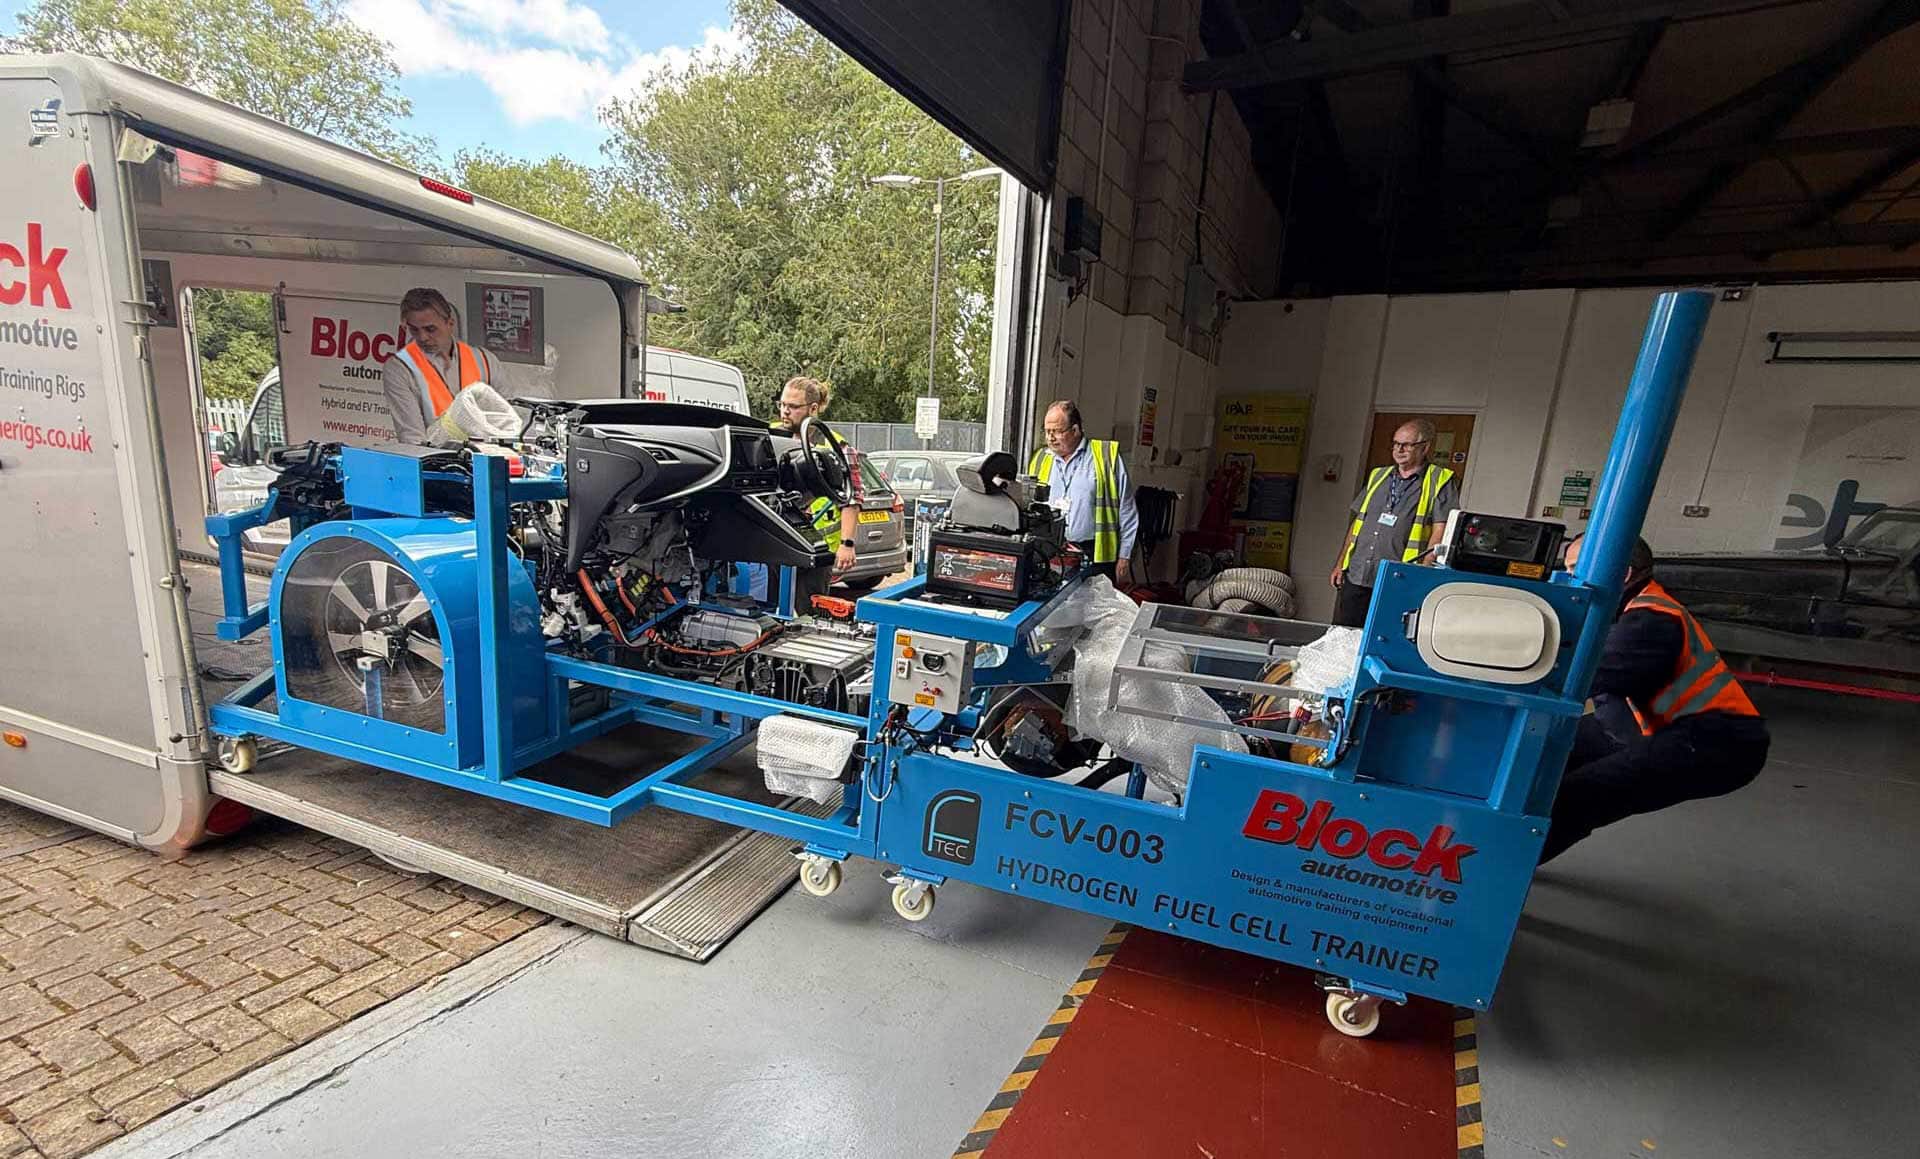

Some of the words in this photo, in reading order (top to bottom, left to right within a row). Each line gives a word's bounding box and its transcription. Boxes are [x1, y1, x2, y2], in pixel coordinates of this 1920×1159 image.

[56, 374, 86, 402] Rigs
[321, 397, 346, 410] Hybrid
[347, 401, 362, 412] and
[362, 401, 373, 413] EV
[941, 566, 953, 576] Pb
[1004, 802, 1165, 864] FCV-003
[1241, 788, 1479, 883] Block
[1231, 868, 1271, 888] Design
[1274, 878, 1283, 889] &
[1286, 883, 1370, 909] manufacturers
[1374, 902, 1388, 912] of
[1390, 906, 1455, 928] vocational
[1301, 857, 1458, 905] automotive
[996, 855, 1139, 908] HYDROGEN
[1154, 893, 1220, 930] FUEL
[1229, 910, 1293, 946] CELL
[1310, 930, 1440, 981] TRAINER
[1248, 886, 1313, 907] automotive
[1316, 900, 1361, 921] training
[1363, 912, 1429, 935] equipment
